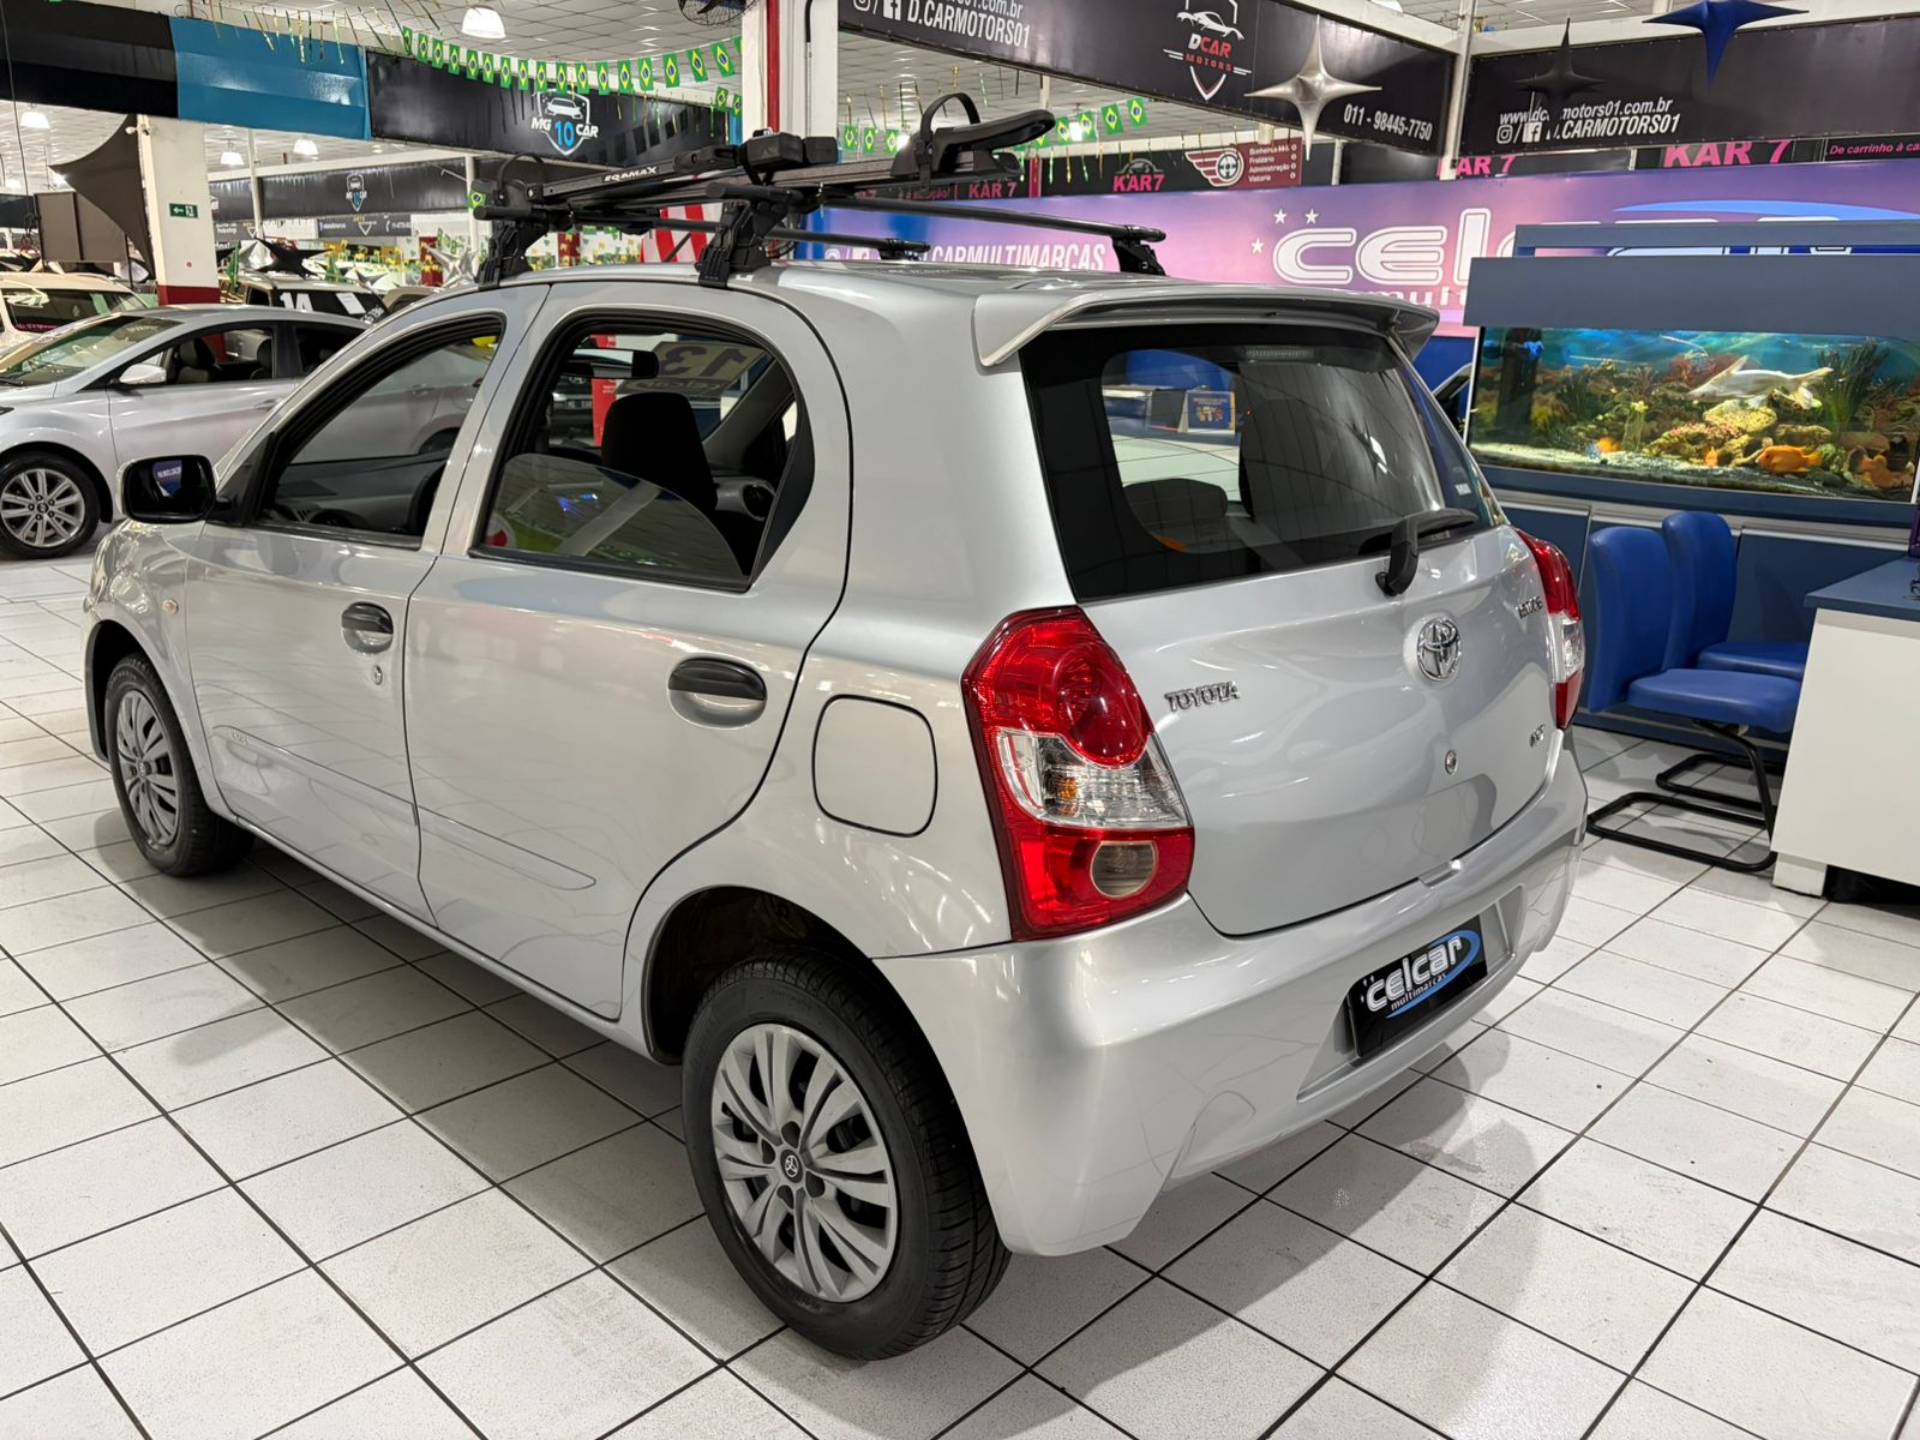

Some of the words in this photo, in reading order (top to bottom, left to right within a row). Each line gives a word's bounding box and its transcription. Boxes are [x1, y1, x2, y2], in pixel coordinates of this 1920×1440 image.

[907, 0, 1031, 48] D.CARMOTORS01
[1188, 33, 1232, 58] DCAR
[1184, 54, 1233, 72] MOTORS
[1343, 103, 1365, 126] 011
[1373, 110, 1433, 141] 98445-7750
[1500, 97, 1673, 126] www.dcmotors01.com.br
[531, 117, 552, 131] MG
[555, 121, 575, 148] 10
[576, 123, 599, 138] CAR
[1664, 142, 1753, 168] KAR
[1767, 139, 1793, 165] 7
[1830, 145, 1844, 155] De
[1847, 144, 1893, 154] carrinho
[1500, 155, 1517, 175] 7
[968, 184, 1002, 199] KAR
[1007, 182, 1018, 197] 7
[923, 243, 1106, 271] CARMULTIMARCAS
[1164, 680, 1241, 713] TOYOTA
[1366, 935, 1463, 1012] celcar
